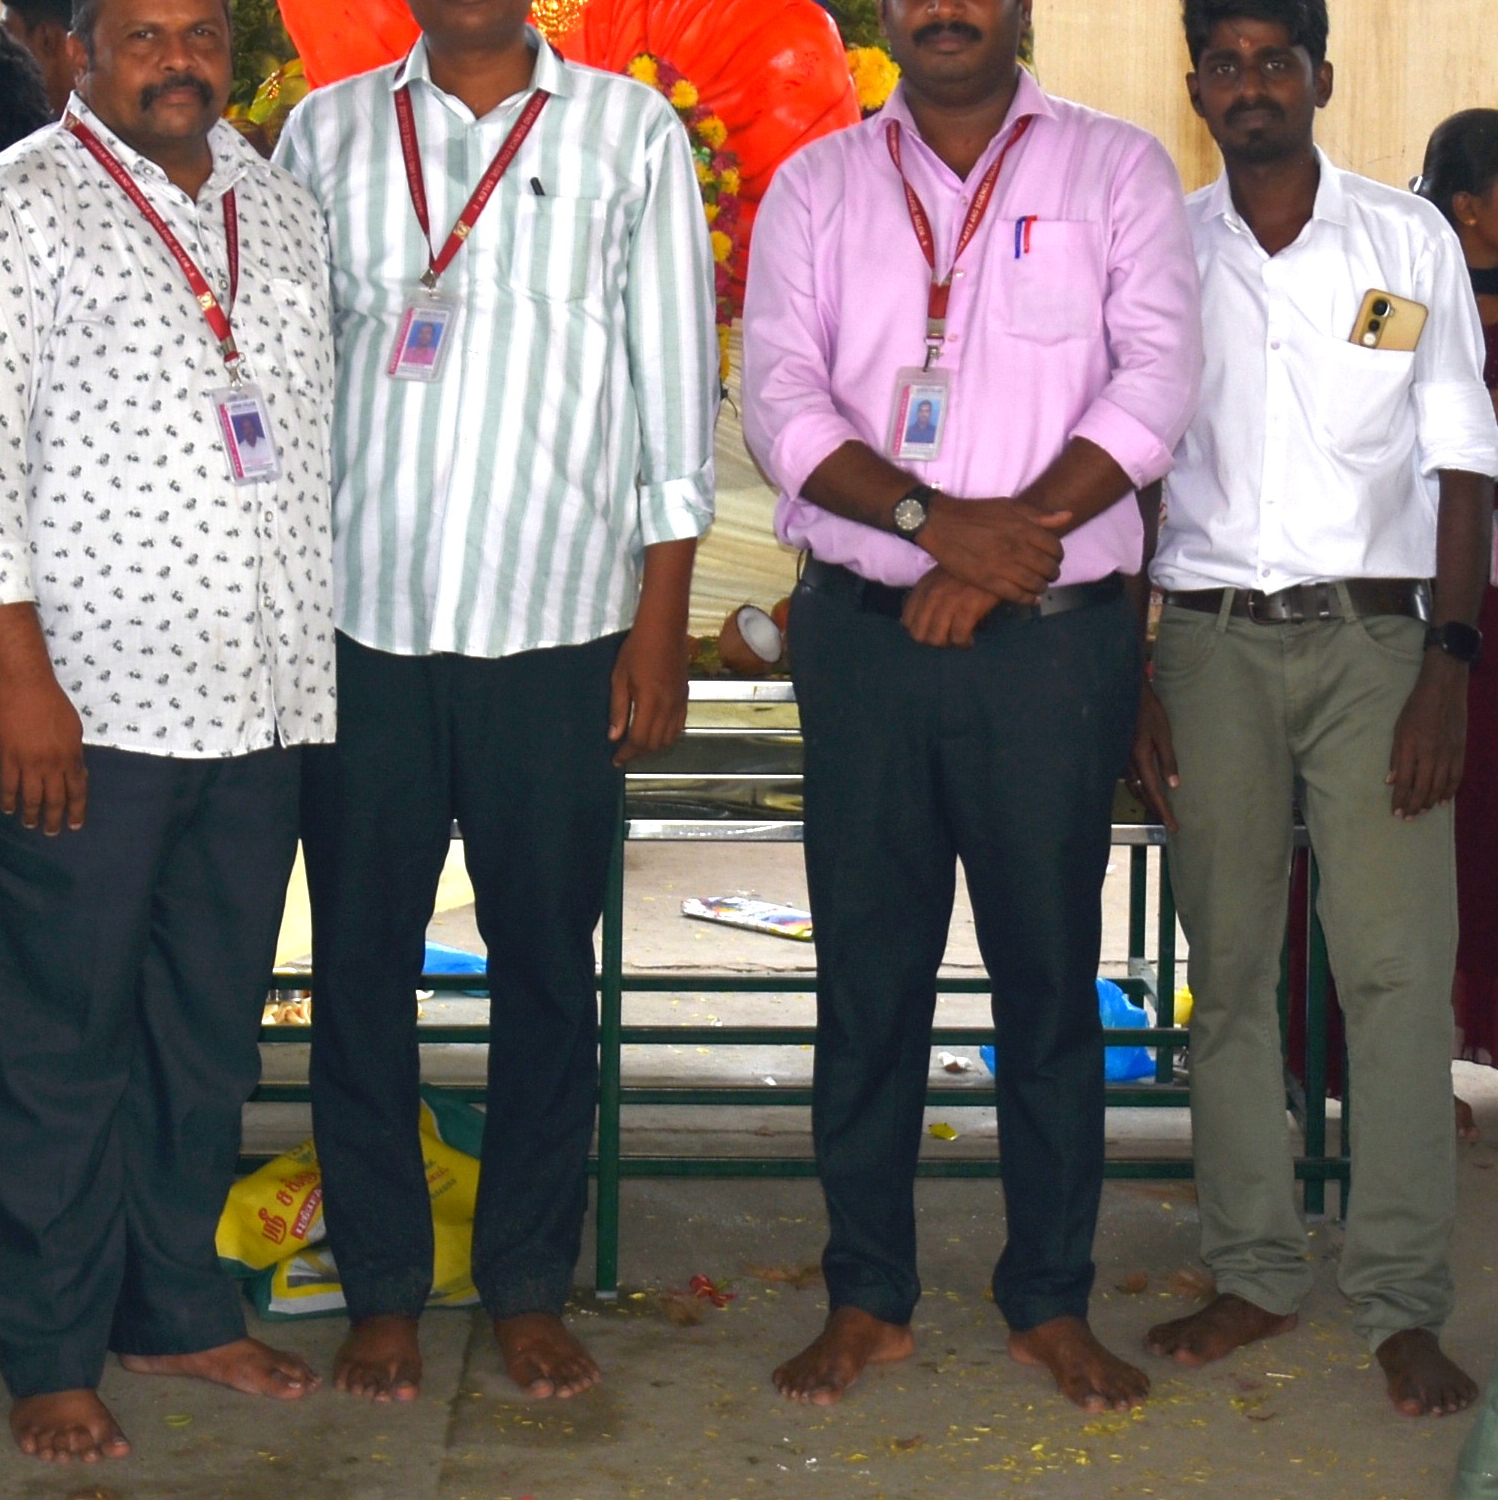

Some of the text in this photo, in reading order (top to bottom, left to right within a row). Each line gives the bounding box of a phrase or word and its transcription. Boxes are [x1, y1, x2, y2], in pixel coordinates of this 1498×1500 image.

[961, 222, 973, 241] ARTS
[968, 208, 979, 223] AND
[974, 181, 990, 209] SCIENCE
